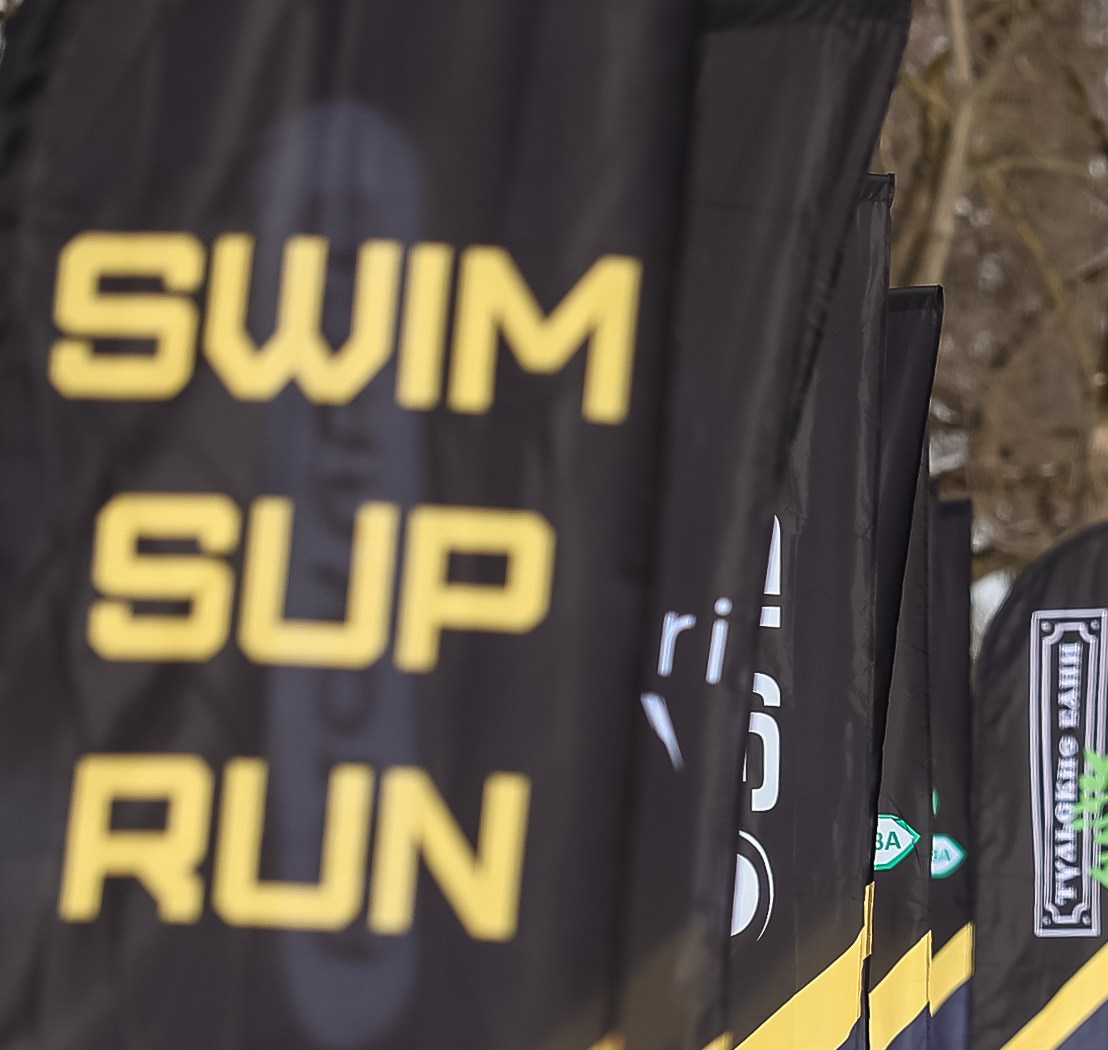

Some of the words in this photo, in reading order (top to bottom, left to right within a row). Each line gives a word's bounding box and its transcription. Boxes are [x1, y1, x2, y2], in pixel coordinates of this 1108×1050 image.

[49, 231, 642, 424] SWIM
[87, 493, 557, 672] SUP
[59, 753, 531, 942] RUN
